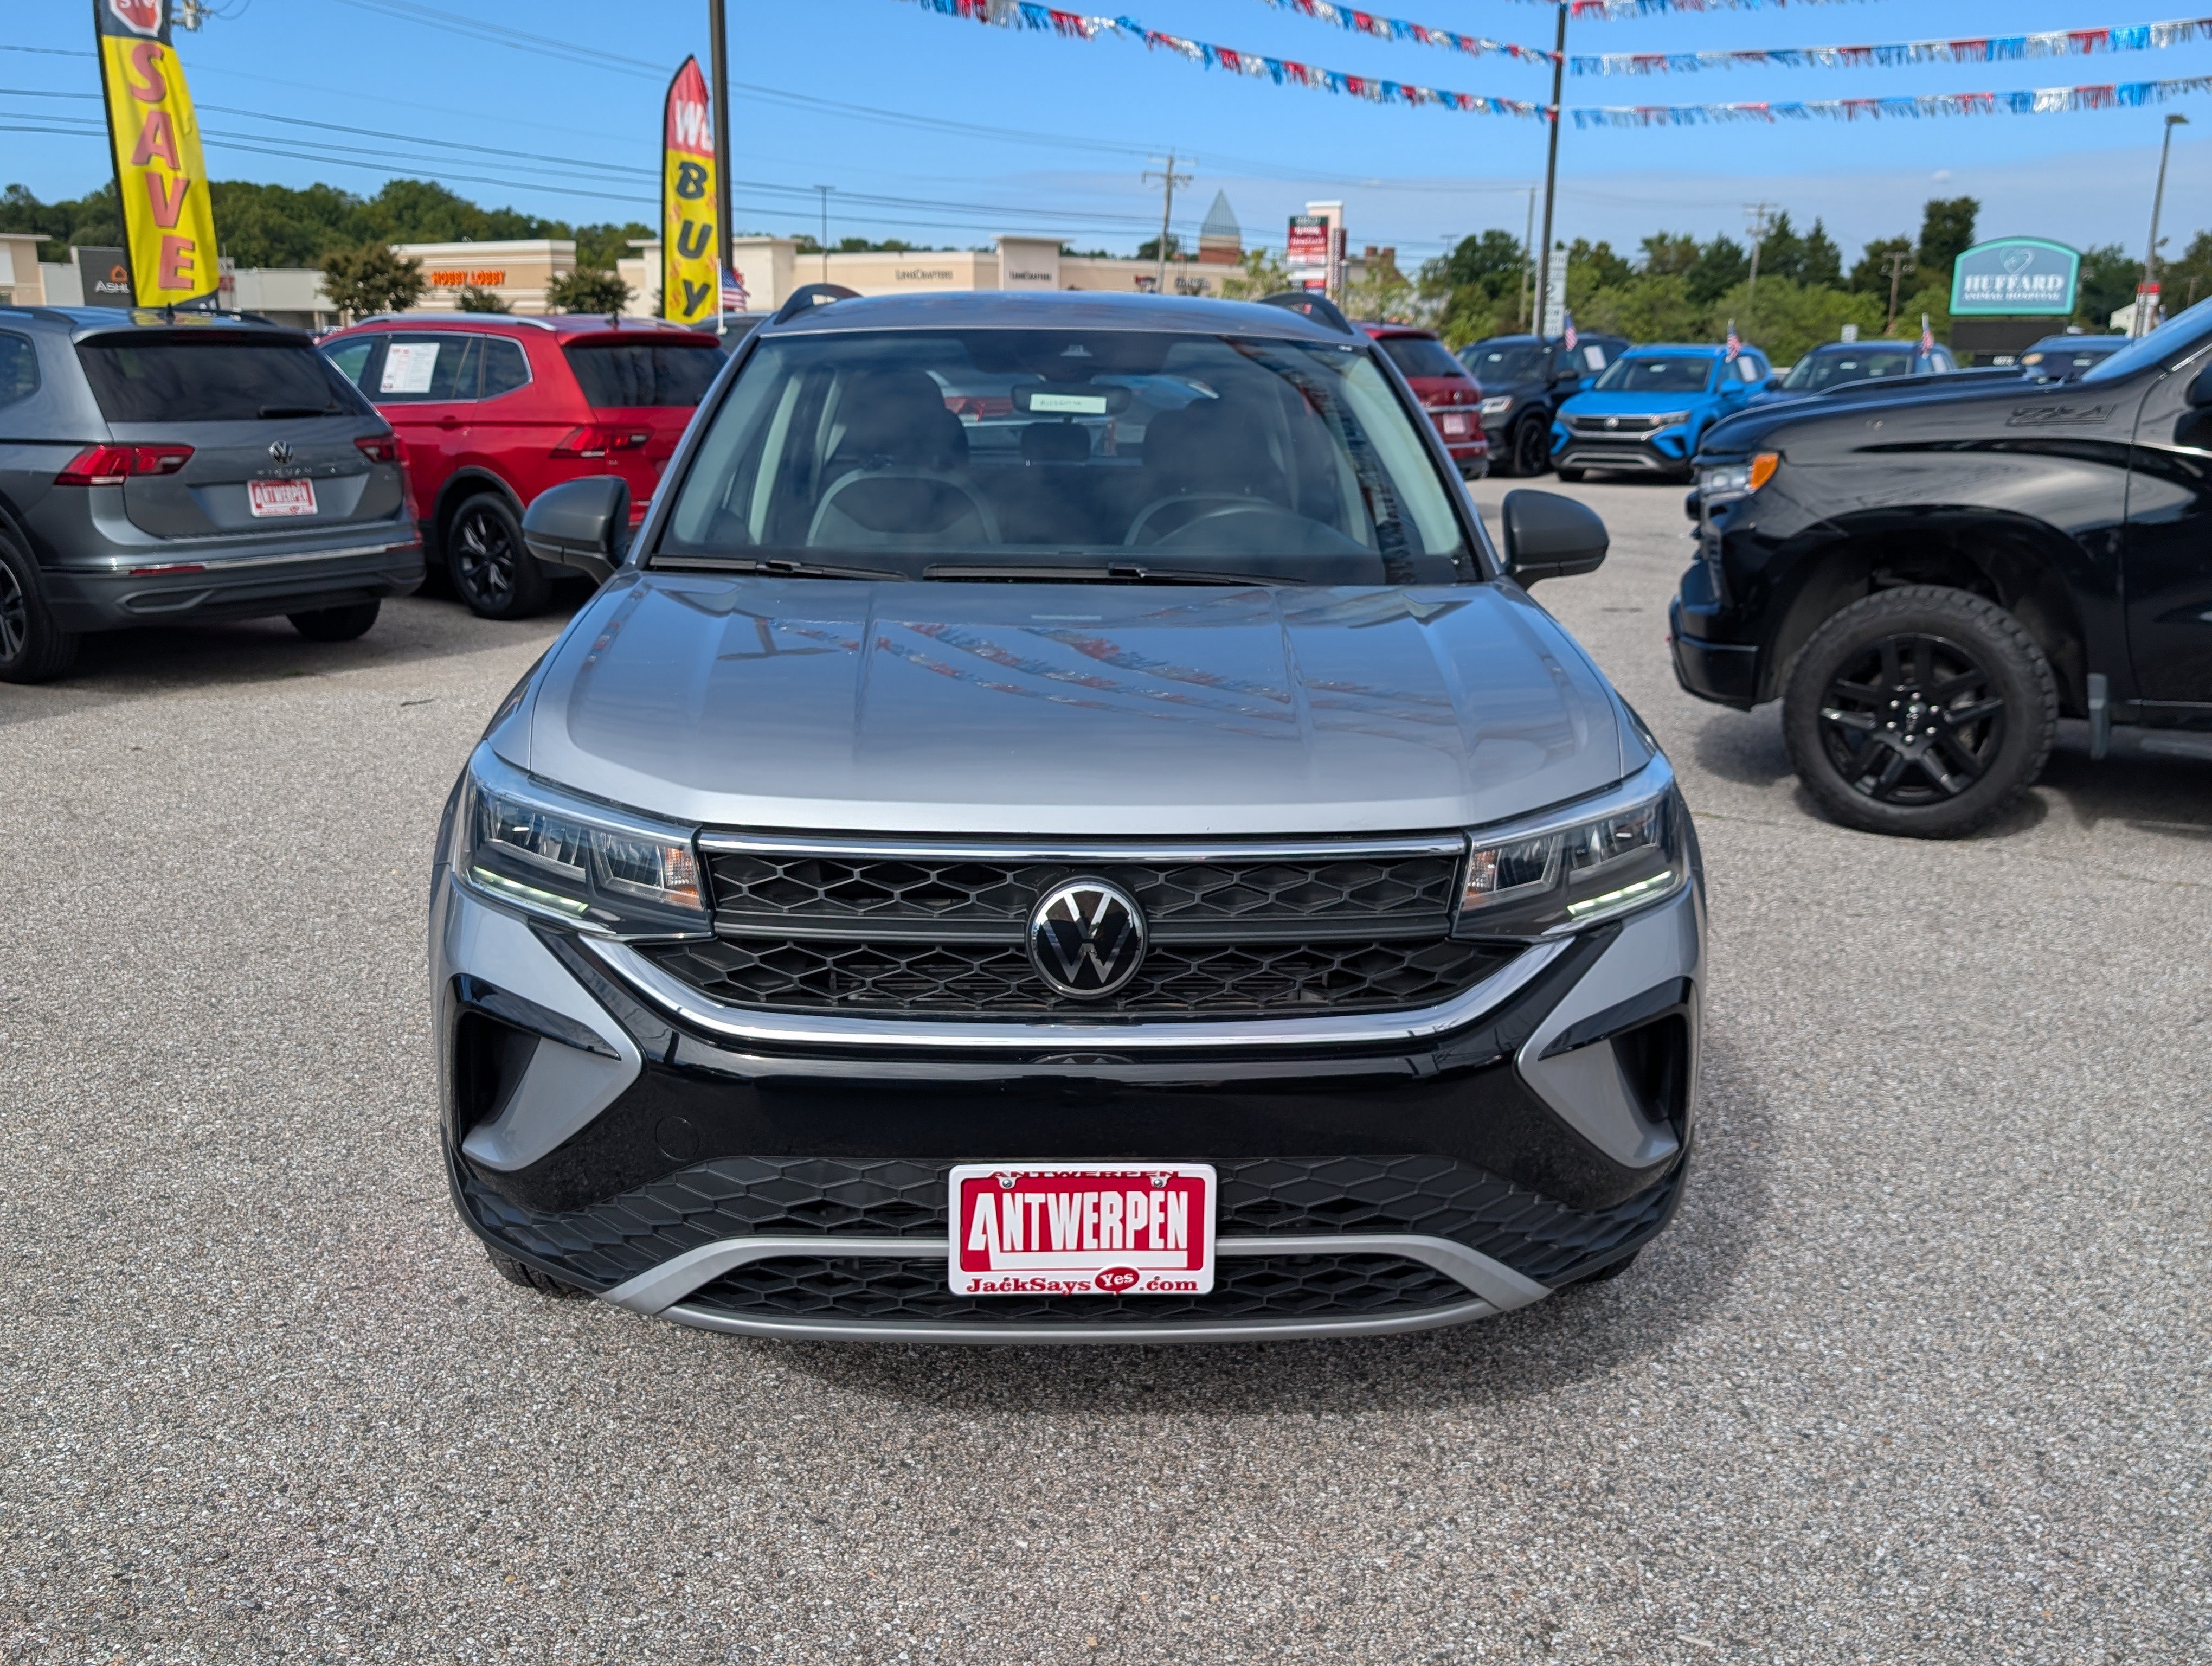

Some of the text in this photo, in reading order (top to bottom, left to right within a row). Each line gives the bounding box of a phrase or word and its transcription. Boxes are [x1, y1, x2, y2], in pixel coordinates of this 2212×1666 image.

[130, 42, 195, 290] SAVE
[676, 160, 712, 317] BUY
[1964, 274, 2065, 292] HUFFARD
[968, 1191, 1188, 1252] ANTWERPEN
